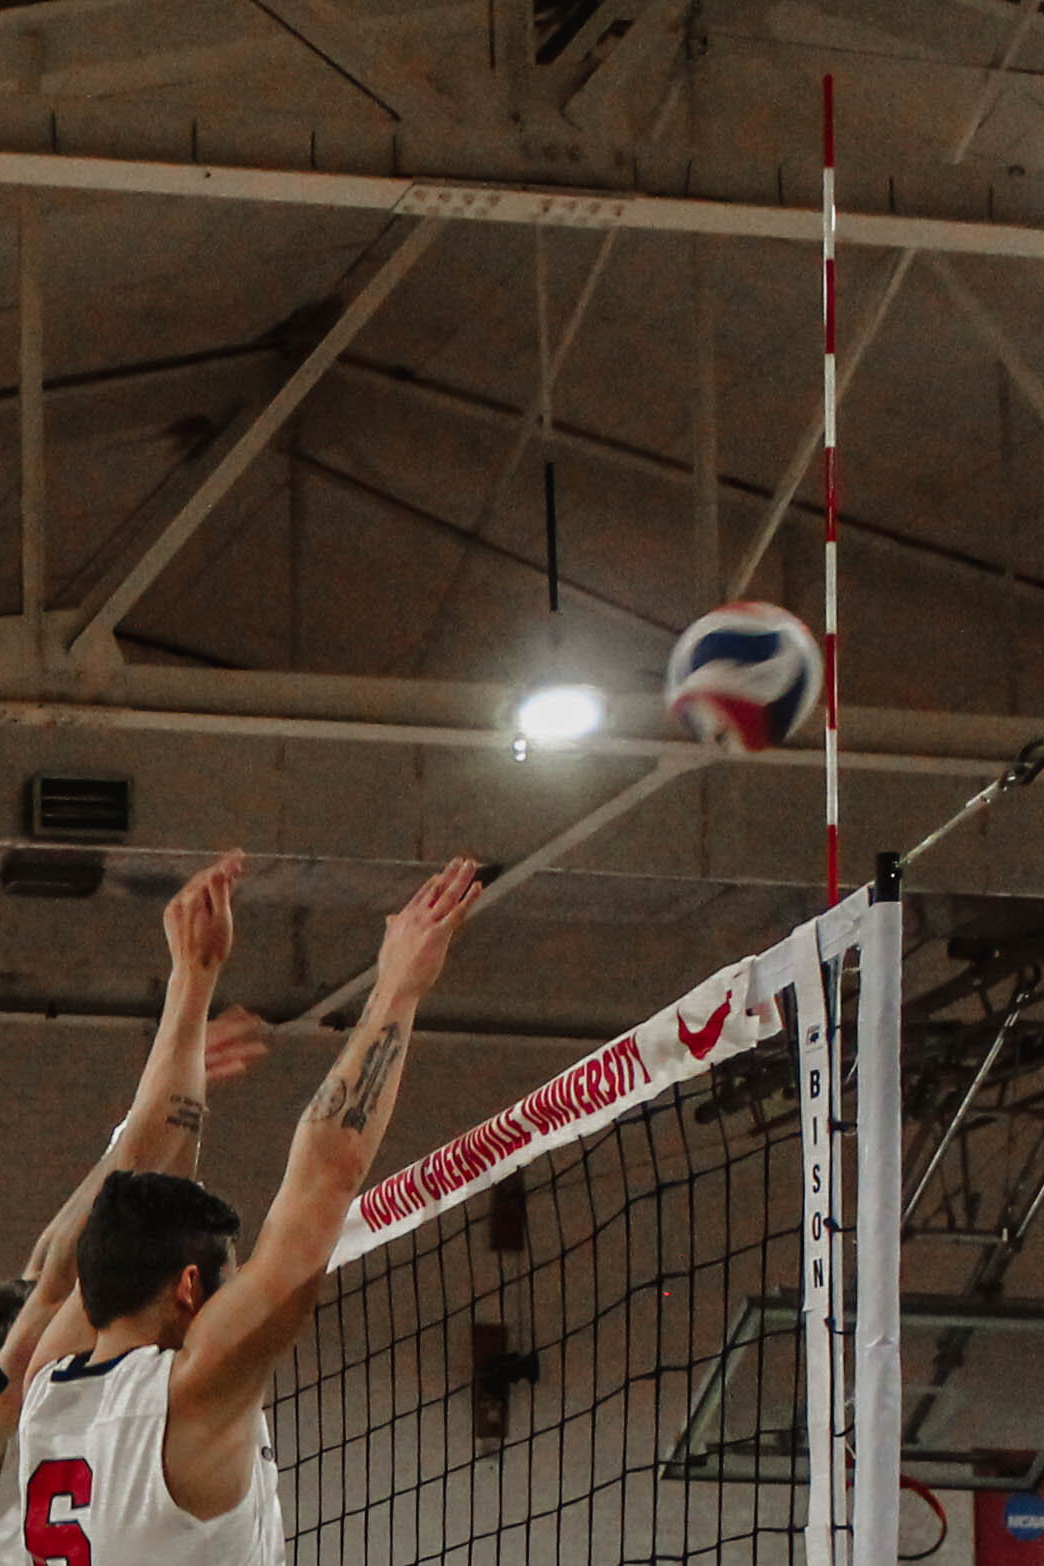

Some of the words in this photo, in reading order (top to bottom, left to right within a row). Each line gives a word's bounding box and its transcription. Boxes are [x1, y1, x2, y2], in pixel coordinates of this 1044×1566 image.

[359, 1170, 427, 1233] NORTH
[420, 1107, 533, 1201] GREENVILLE
[521, 1032, 652, 1136] UNIVERSITY
[809, 1069, 824, 1289] BISON
